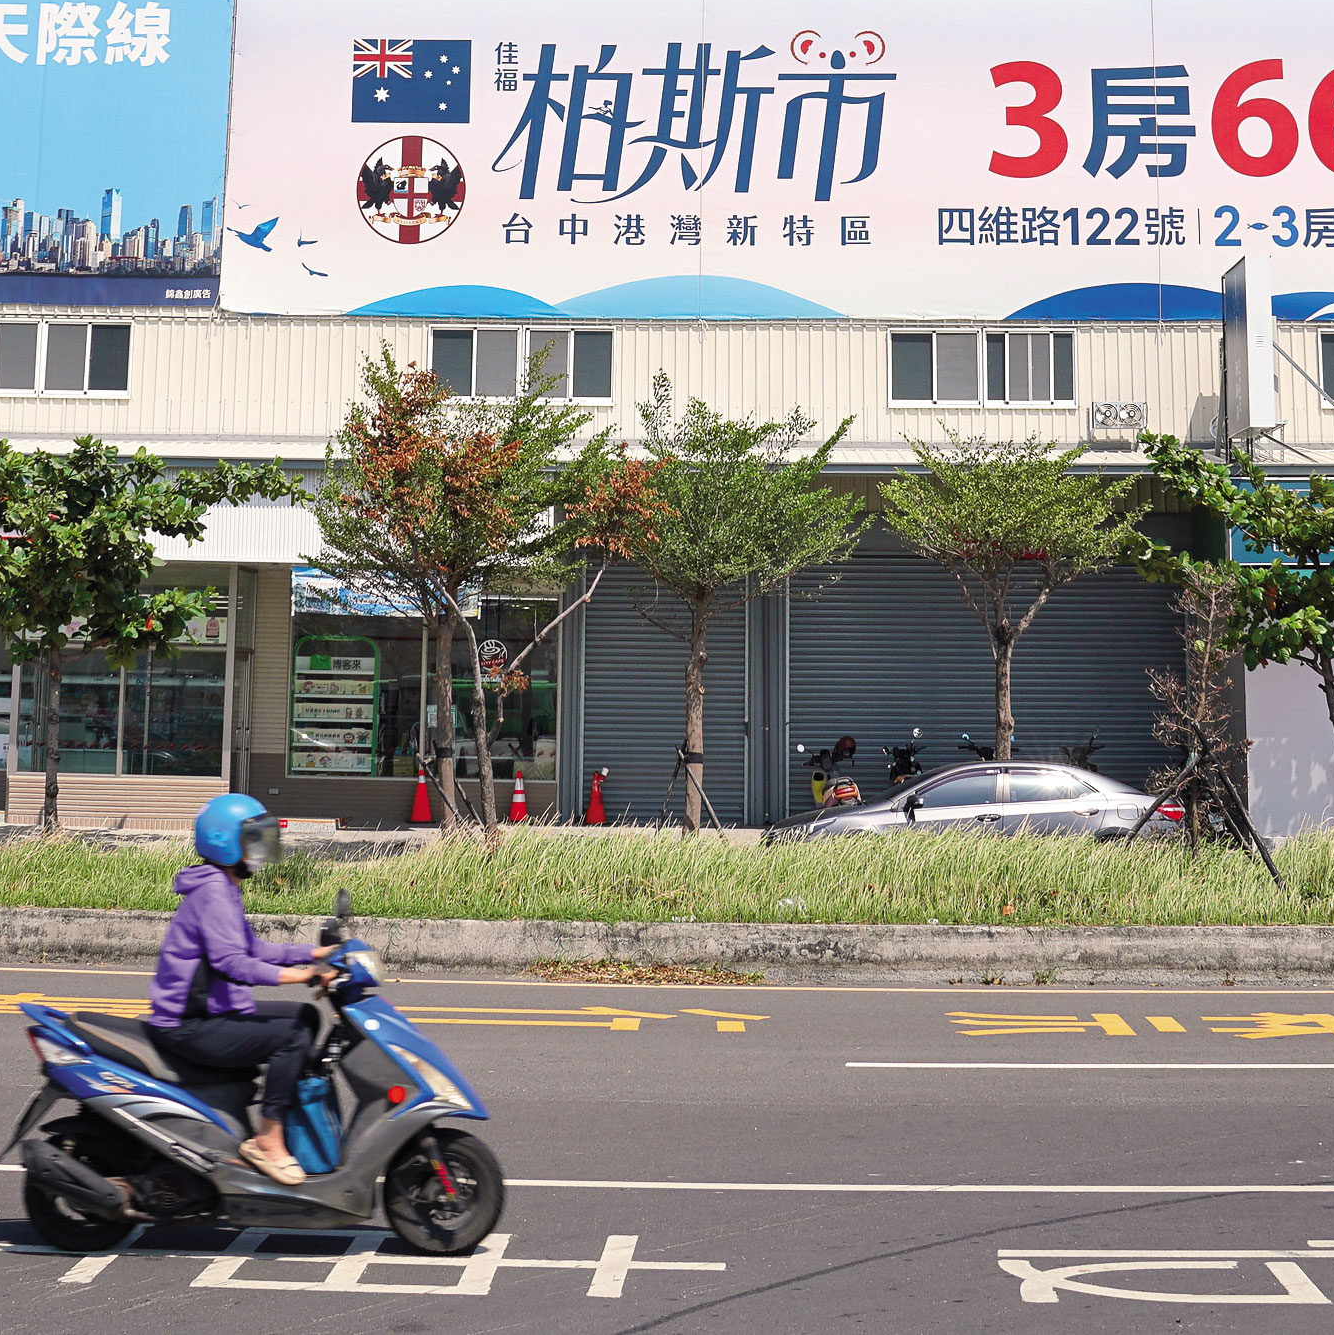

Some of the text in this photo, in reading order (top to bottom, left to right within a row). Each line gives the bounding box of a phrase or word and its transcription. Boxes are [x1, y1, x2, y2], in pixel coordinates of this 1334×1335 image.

[494, 41, 519, 92] 佳福
[491, 42, 897, 203] 柏斯市
[501, 212, 872, 246] 台中港灣新特區
[937, 205, 1186, 247] 四維路122號
